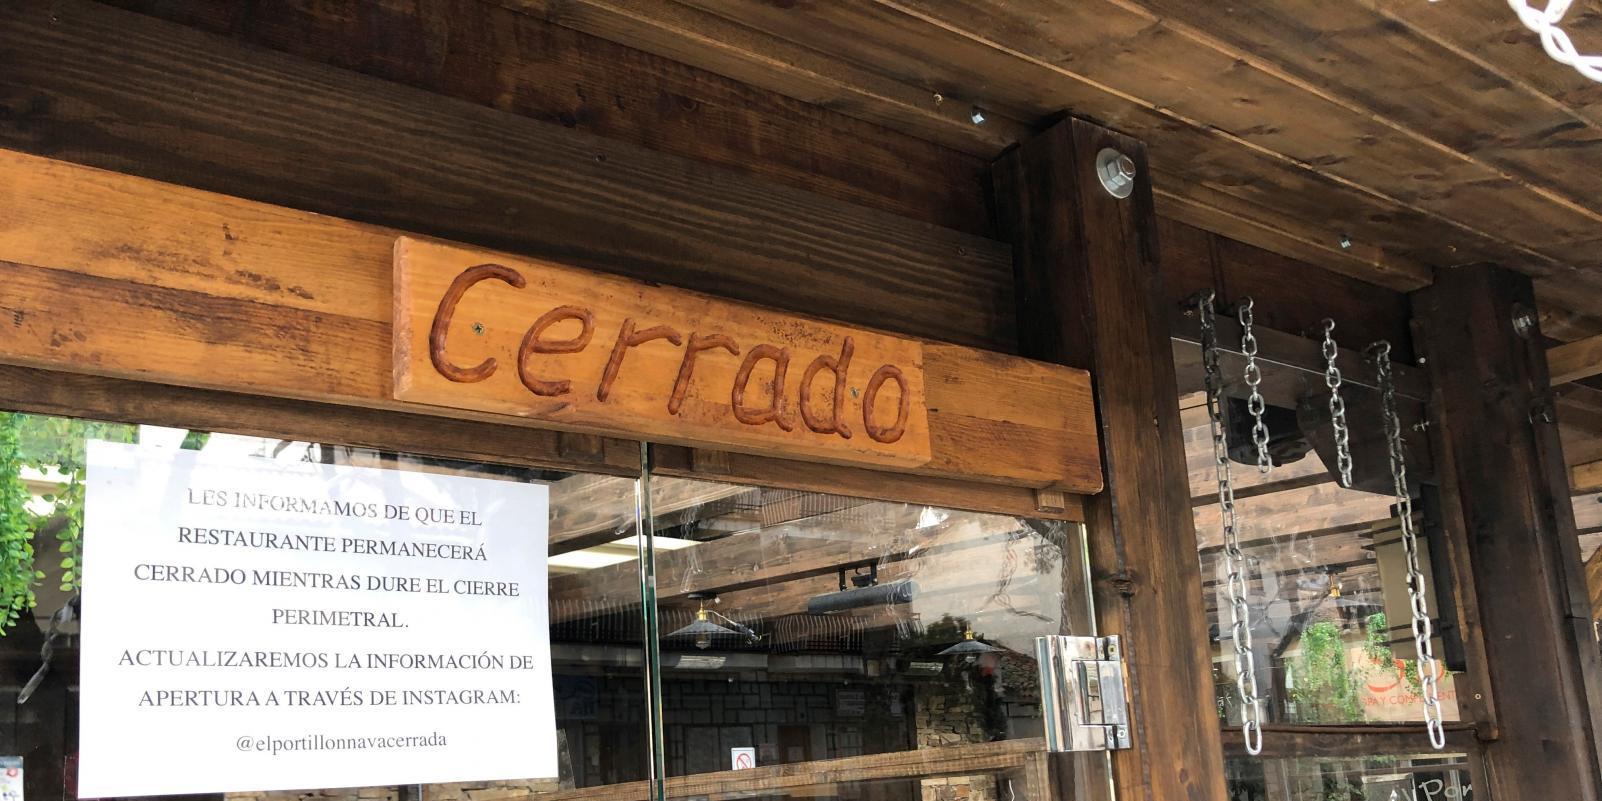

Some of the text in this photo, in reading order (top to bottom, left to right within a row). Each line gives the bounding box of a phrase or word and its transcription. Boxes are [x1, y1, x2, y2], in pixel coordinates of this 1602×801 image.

[428, 263, 910, 444] Cerrado
[188, 487, 482, 526] LES INFORMAMOS DE QUE EL
[177, 526, 488, 562] RESTAURANTE PERMANECERÁ
[133, 563, 519, 597] CERRADO MIENTRAS DURE EL CIERRE
[272, 609, 409, 629] PERIMETRAL.
[118, 649, 534, 670] ACTUALIZAREMOS LA INFORMACIÓN DE
[139, 686, 521, 707] APERTURA A TRAVÉS DE INSTAGRAM:
[236, 731, 447, 756] @elportillonnavacerrada
